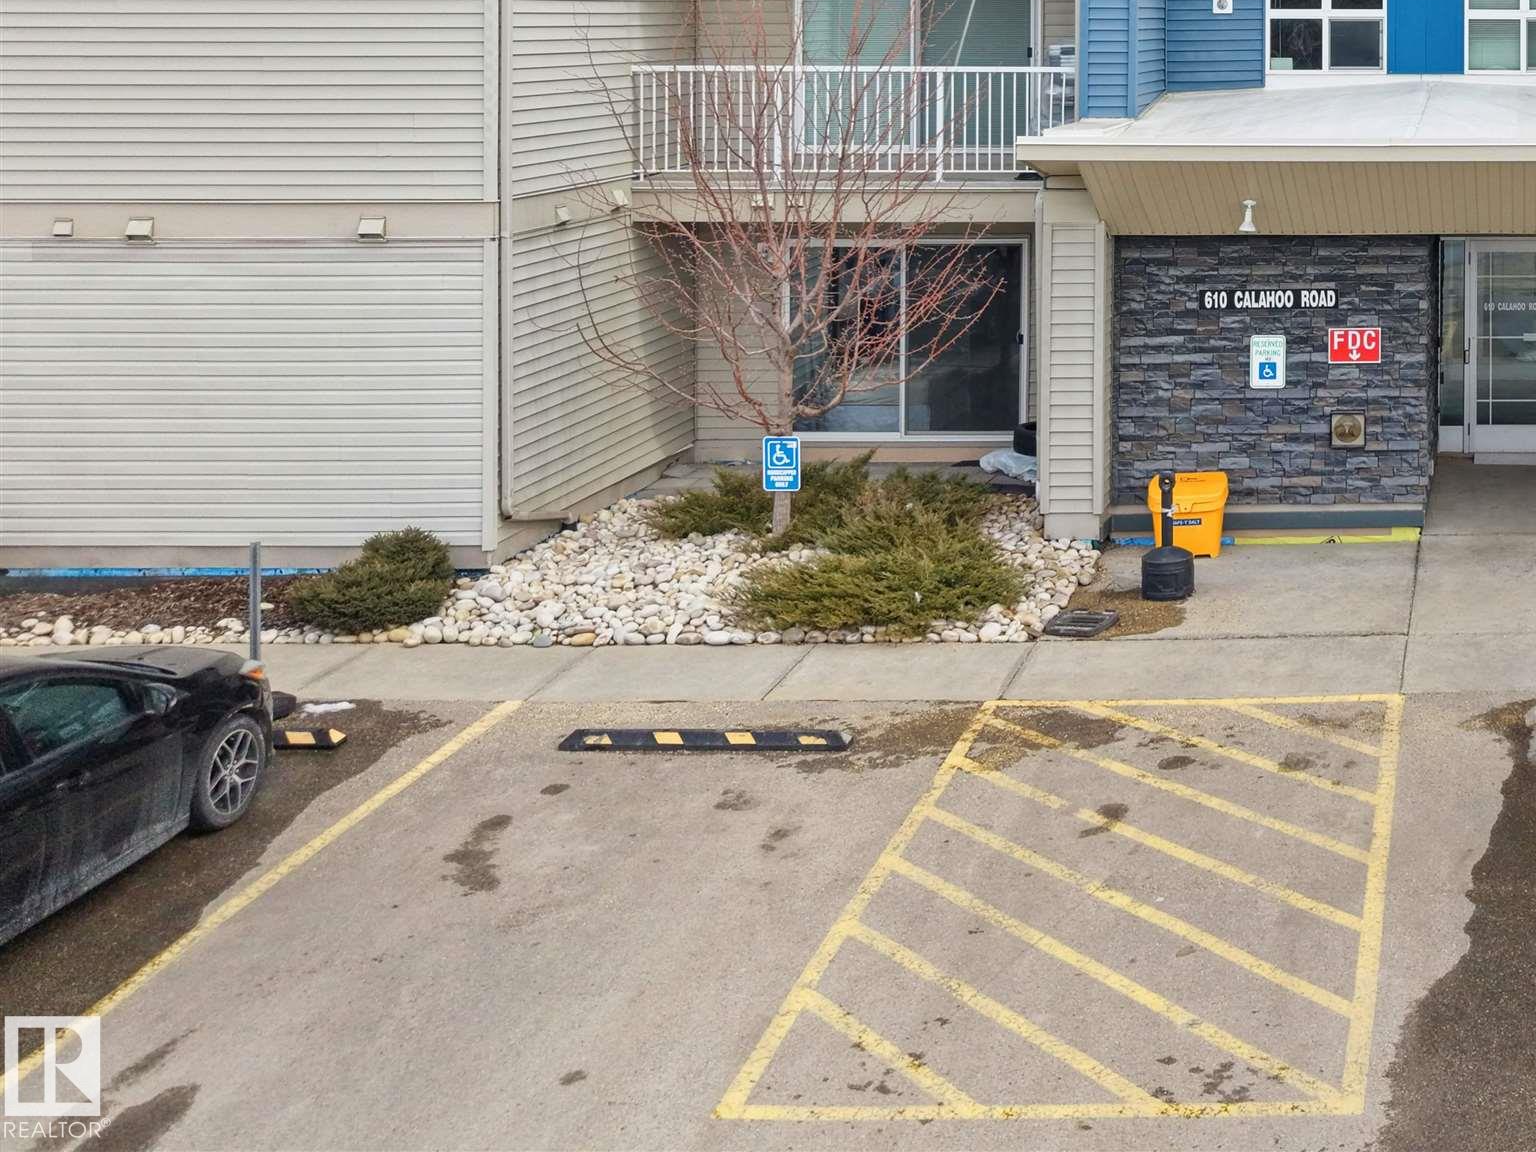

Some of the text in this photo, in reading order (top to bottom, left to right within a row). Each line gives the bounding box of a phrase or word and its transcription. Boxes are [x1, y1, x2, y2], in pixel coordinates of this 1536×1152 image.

[1204, 290, 1336, 308] 610 CALAHOO ROAD
[1498, 302, 1526, 311] CALAHOO
[1253, 340, 1283, 348] RESERVED
[1333, 330, 1376, 350] FDC
